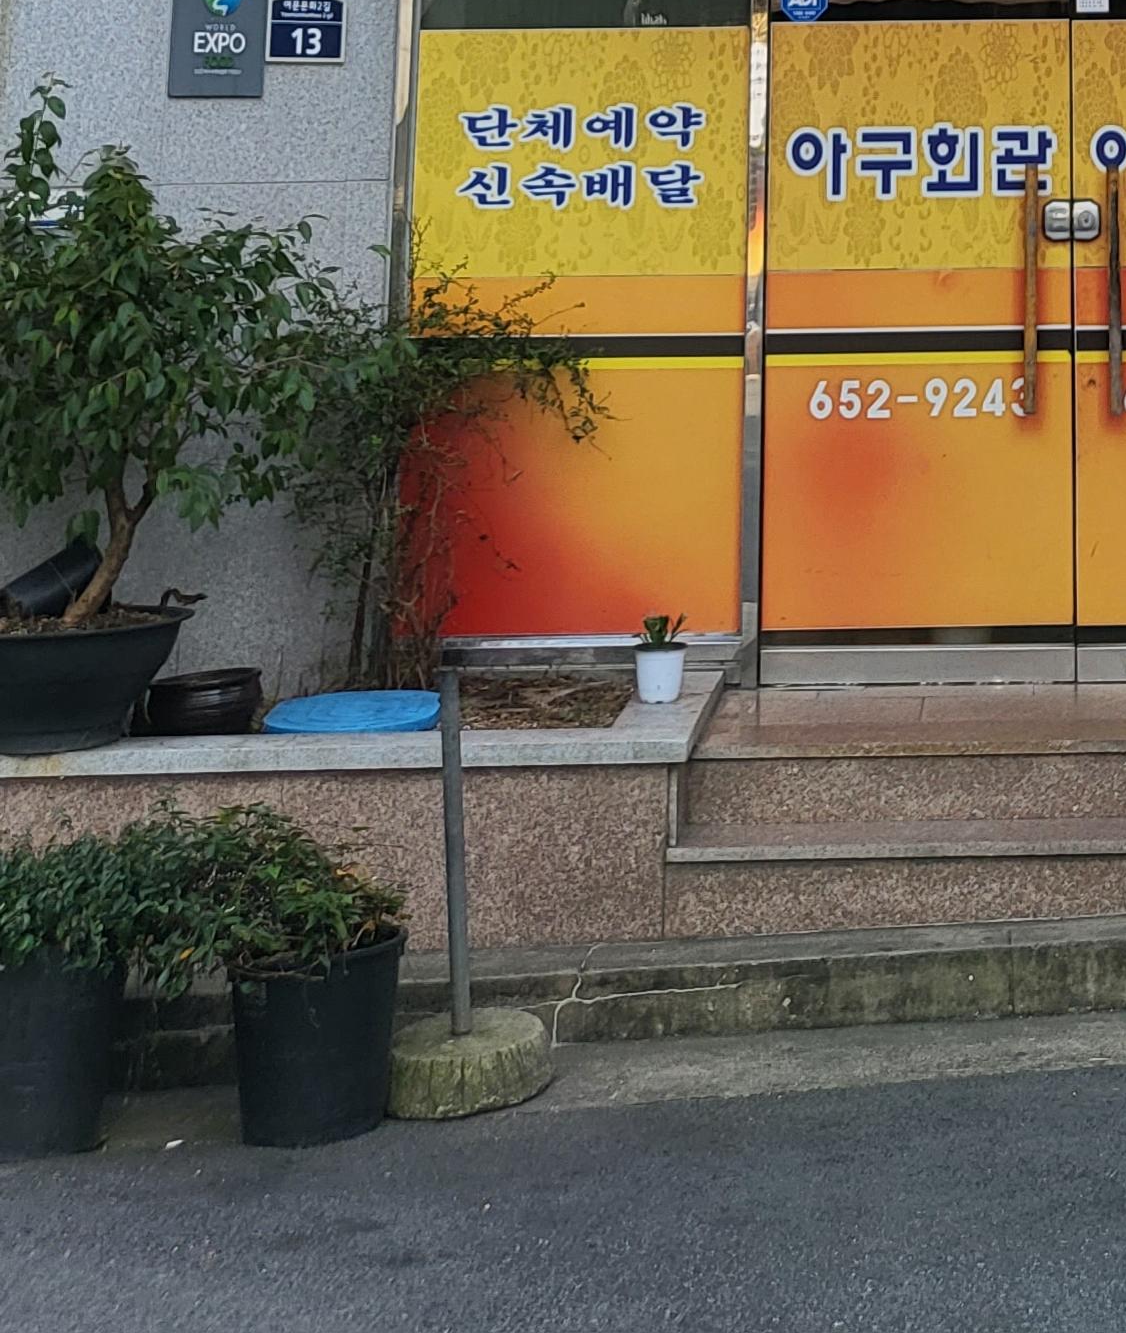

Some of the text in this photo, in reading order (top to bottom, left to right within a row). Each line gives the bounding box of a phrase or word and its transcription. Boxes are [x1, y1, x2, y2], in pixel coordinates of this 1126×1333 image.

[193, 31, 246, 54] EXPO
[205, 23, 237, 32] WORLD
[291, 27, 322, 56] 13
[460, 103, 703, 153] 단체예약
[788, 124, 1054, 200] 아구회관
[459, 164, 702, 208] 신속배달
